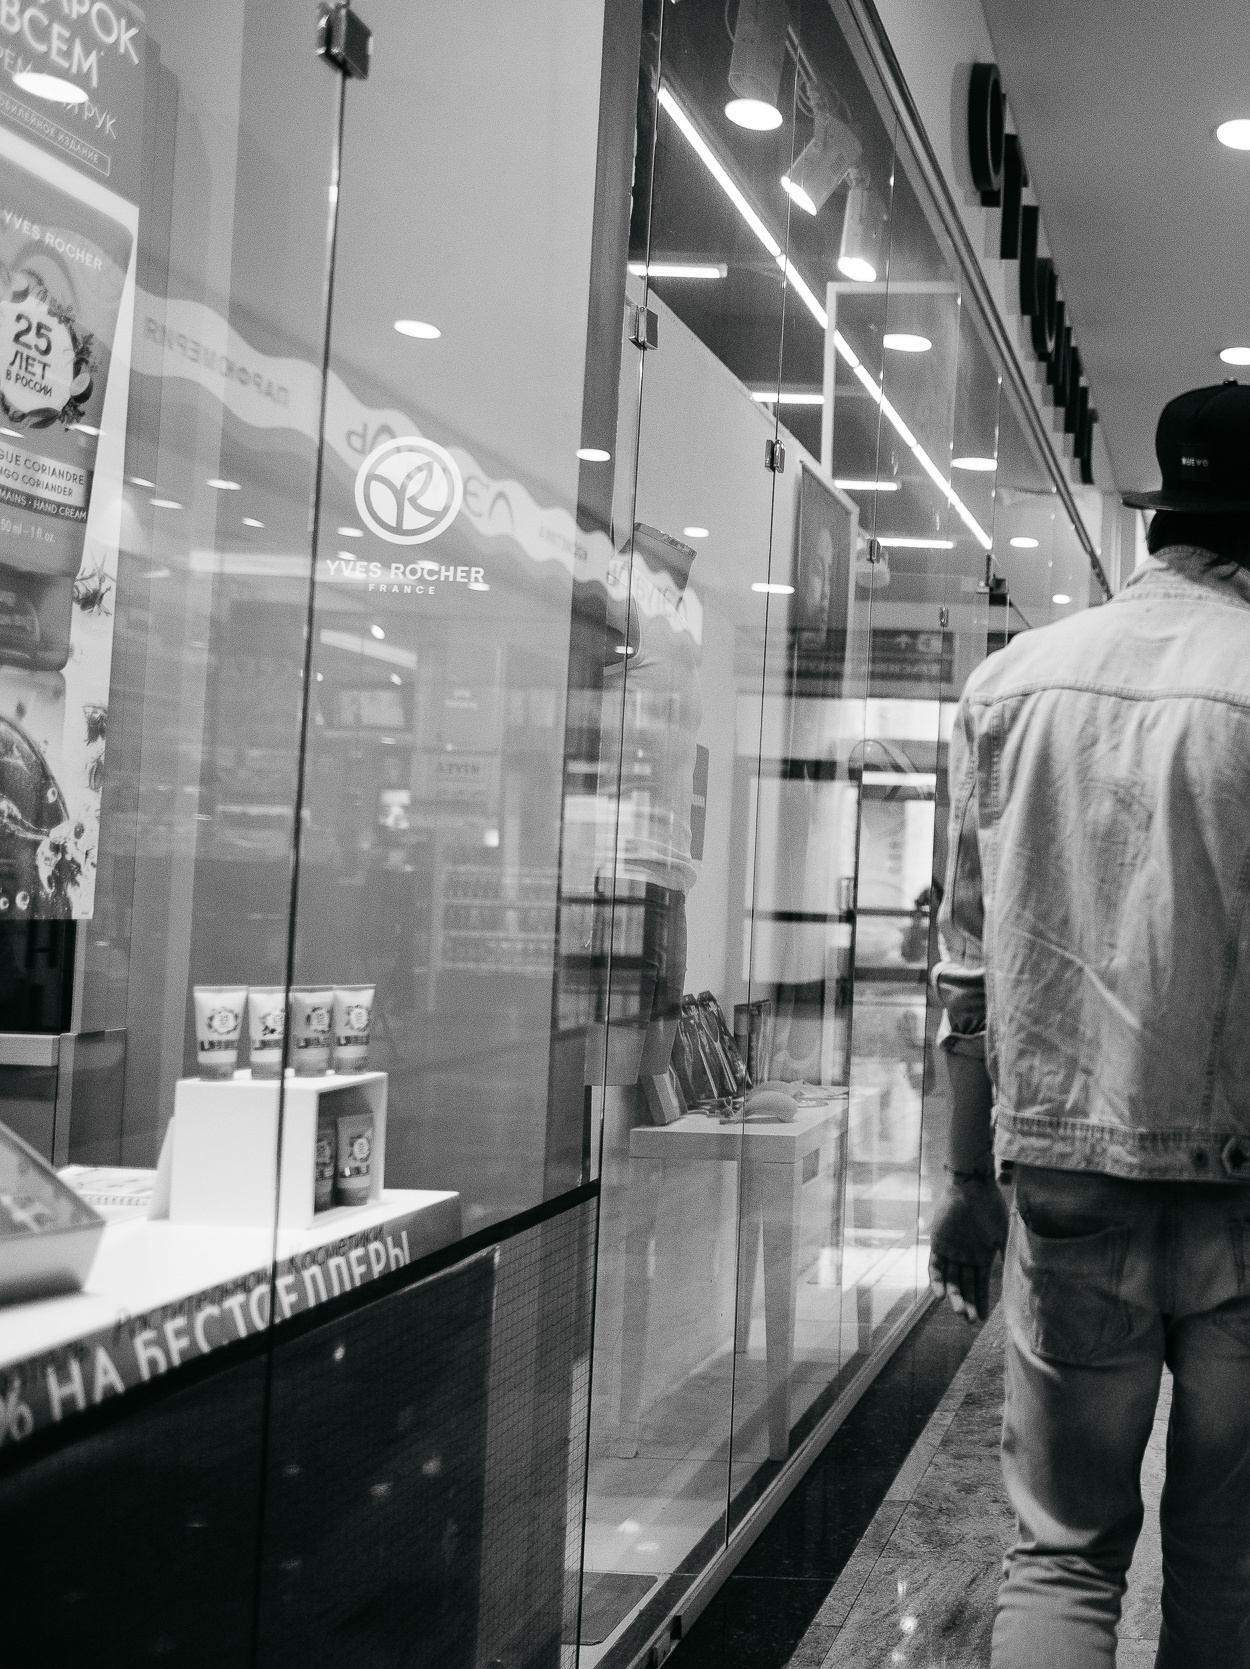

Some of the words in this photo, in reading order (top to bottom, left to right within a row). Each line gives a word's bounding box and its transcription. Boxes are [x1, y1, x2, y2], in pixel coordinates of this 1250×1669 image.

[84, 102, 117, 140] РУК
[4, 208, 41, 241] YVES
[44, 232, 103, 271] ROCHER
[13, 312, 53, 357] 25
[9, 350, 52, 381] ЛЕТ
[15, 372, 53, 398] РОССИИ
[22, 474, 74, 497] CORIANDER
[24, 458, 85, 486] CORIANDRE
[33, 499, 58, 514] HAND
[59, 506, 87, 520] CREAM
[325, 559, 383, 578] YVES
[389, 562, 485, 584] ROCHER
[368, 583, 436, 595] FRANCE
[47, 1346, 125, 1422] НА
